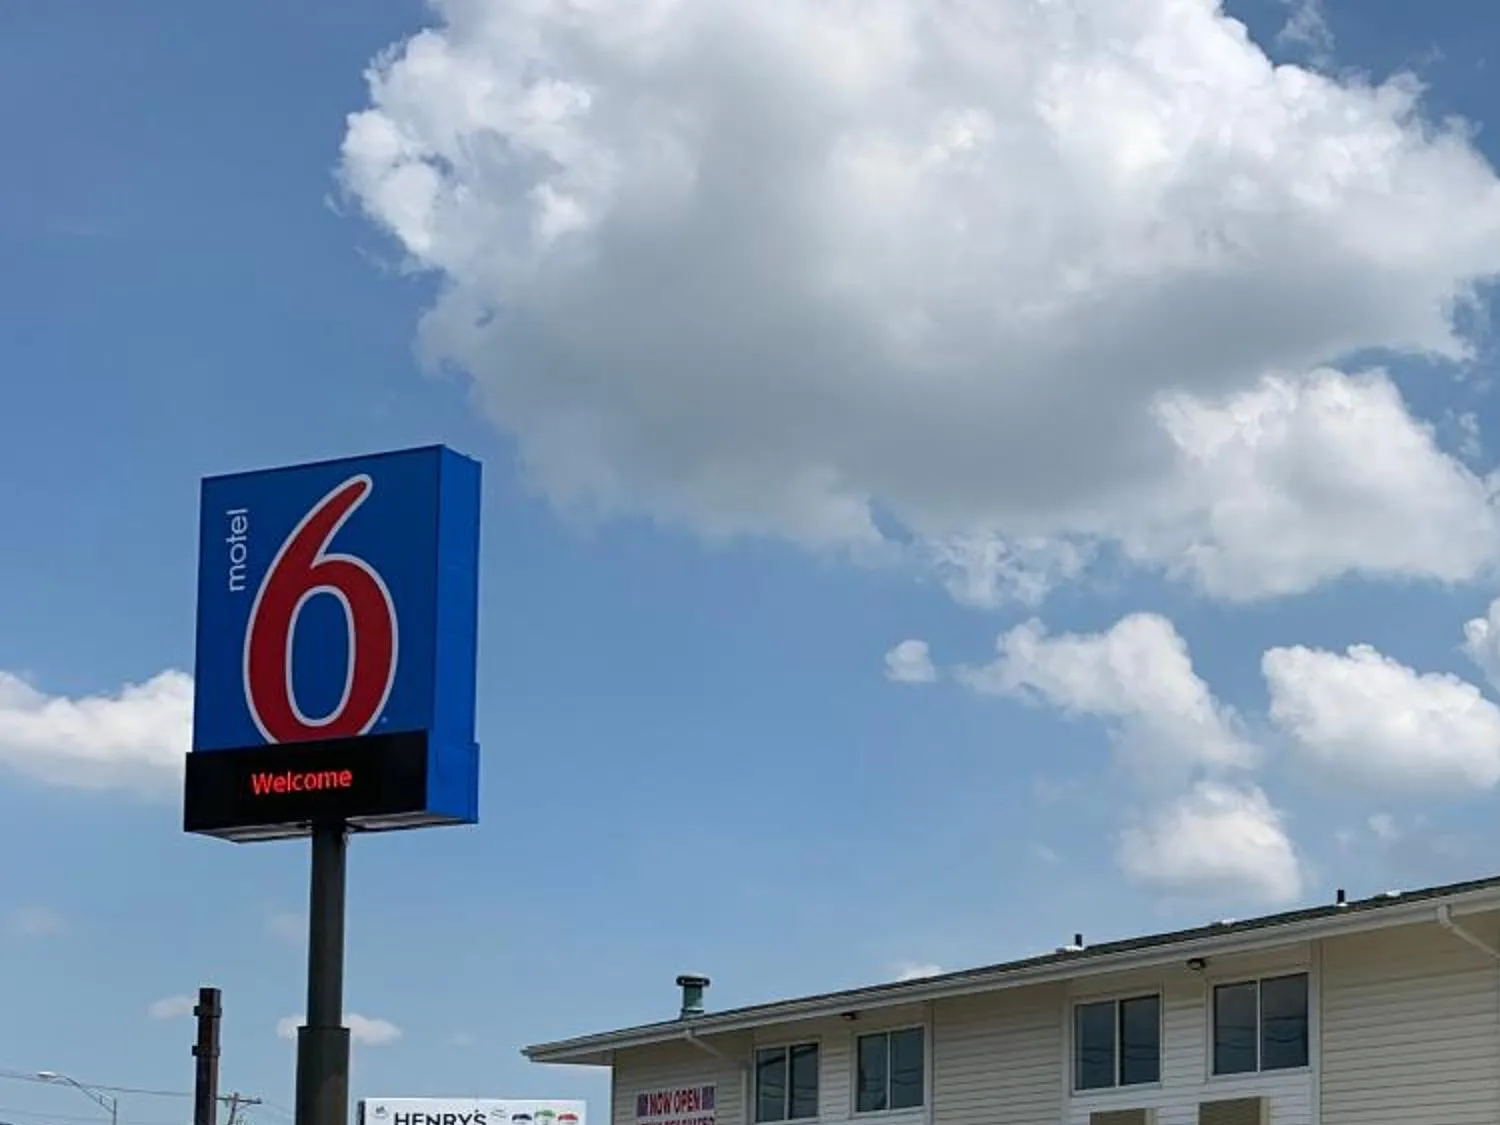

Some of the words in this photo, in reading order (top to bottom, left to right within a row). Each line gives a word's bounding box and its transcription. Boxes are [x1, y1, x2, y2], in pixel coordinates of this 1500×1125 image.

[226, 509, 249, 592] motel
[243, 474, 399, 745] 6
[251, 768, 352, 795] Welcome
[650, 1092, 672, 1116] NOW
[674, 1088, 700, 1114] OPEN
